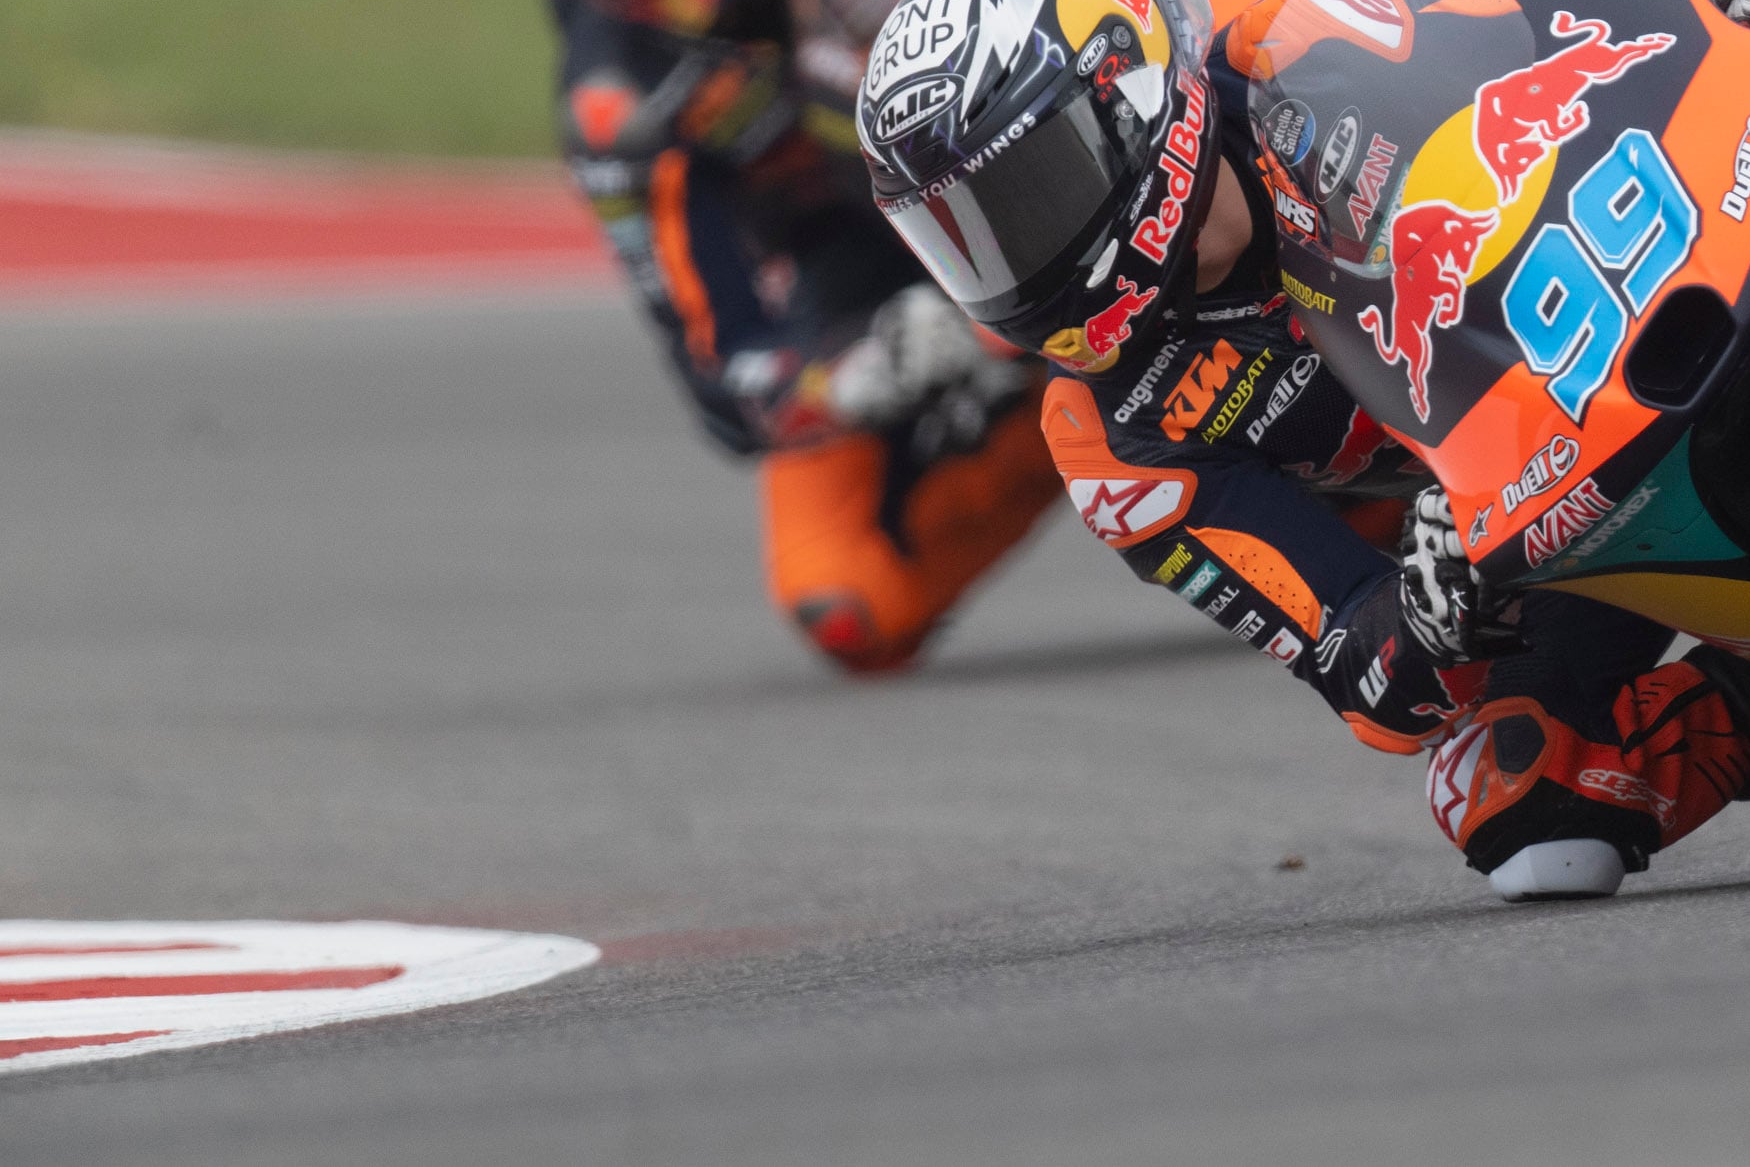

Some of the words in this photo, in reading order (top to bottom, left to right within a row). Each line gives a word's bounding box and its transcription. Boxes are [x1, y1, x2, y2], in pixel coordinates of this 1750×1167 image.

[870, 22, 954, 91] GRUP
[880, 78, 949, 138] HJC
[1271, 108, 1294, 151] Estrella
[1281, 115, 1306, 156] Galicia
[918, 174, 958, 204] YOU
[962, 111, 1037, 174] WINGS
[1130, 152, 1195, 265] Red
[1165, 66, 1206, 170] Bull
[1319, 119, 1356, 192] HJC
[1347, 133, 1399, 242] AVANT
[1275, 187, 1317, 233] WRS
[1281, 269, 1336, 315] MOTOBATT
[1500, 127, 1698, 424] 99
[1159, 337, 1244, 442] KTM
[1200, 347, 1275, 445] MOTOBATT
[1524, 476, 1617, 570] AVANT
[1570, 484, 1660, 557] MOTOREX
